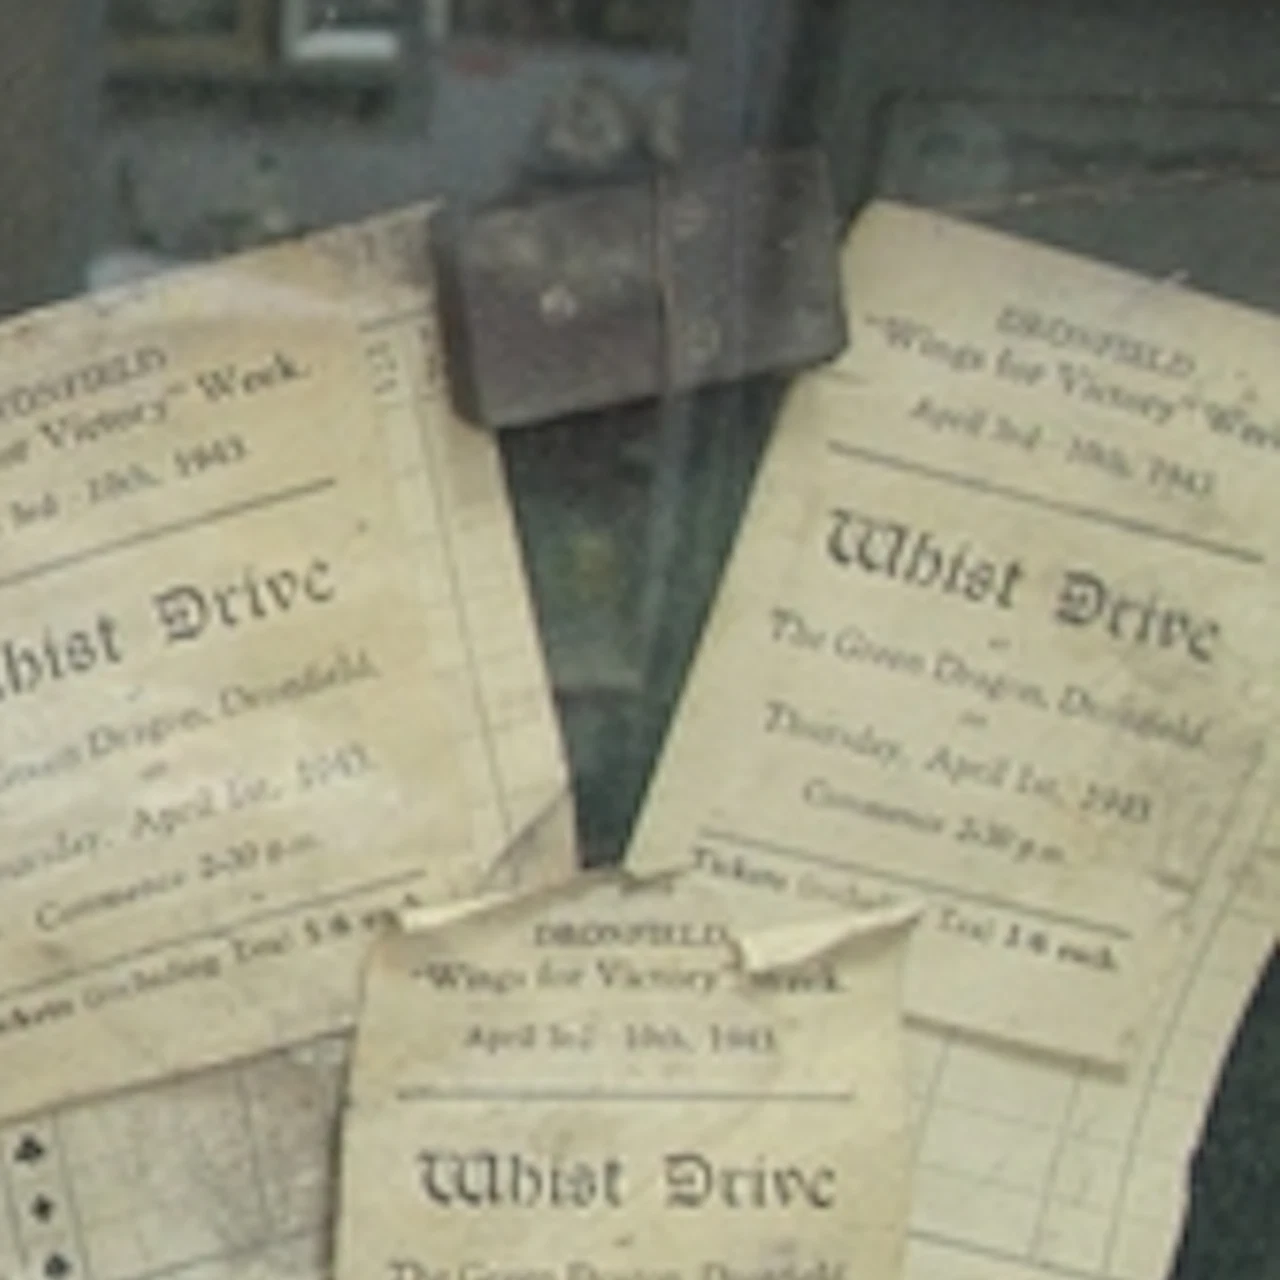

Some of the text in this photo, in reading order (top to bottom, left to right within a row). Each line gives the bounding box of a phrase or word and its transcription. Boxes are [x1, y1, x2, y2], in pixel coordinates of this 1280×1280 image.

[995, 347, 1047, 385] for
[996, 307, 1195, 378] DRONFIELD
[153, 555, 336, 648] Drive
[826, 509, 1220, 662] Whist Drive
[771, 606, 826, 651] The
[835, 626, 926, 674] Green
[924, 746, 1010, 787] April
[132, 788, 215, 838] April
[534, 923, 730, 949] DRONFIELD
[537, 958, 584, 988] for
[466, 1024, 536, 1054] April
[416, 1150, 838, 1209] Whist Drive
